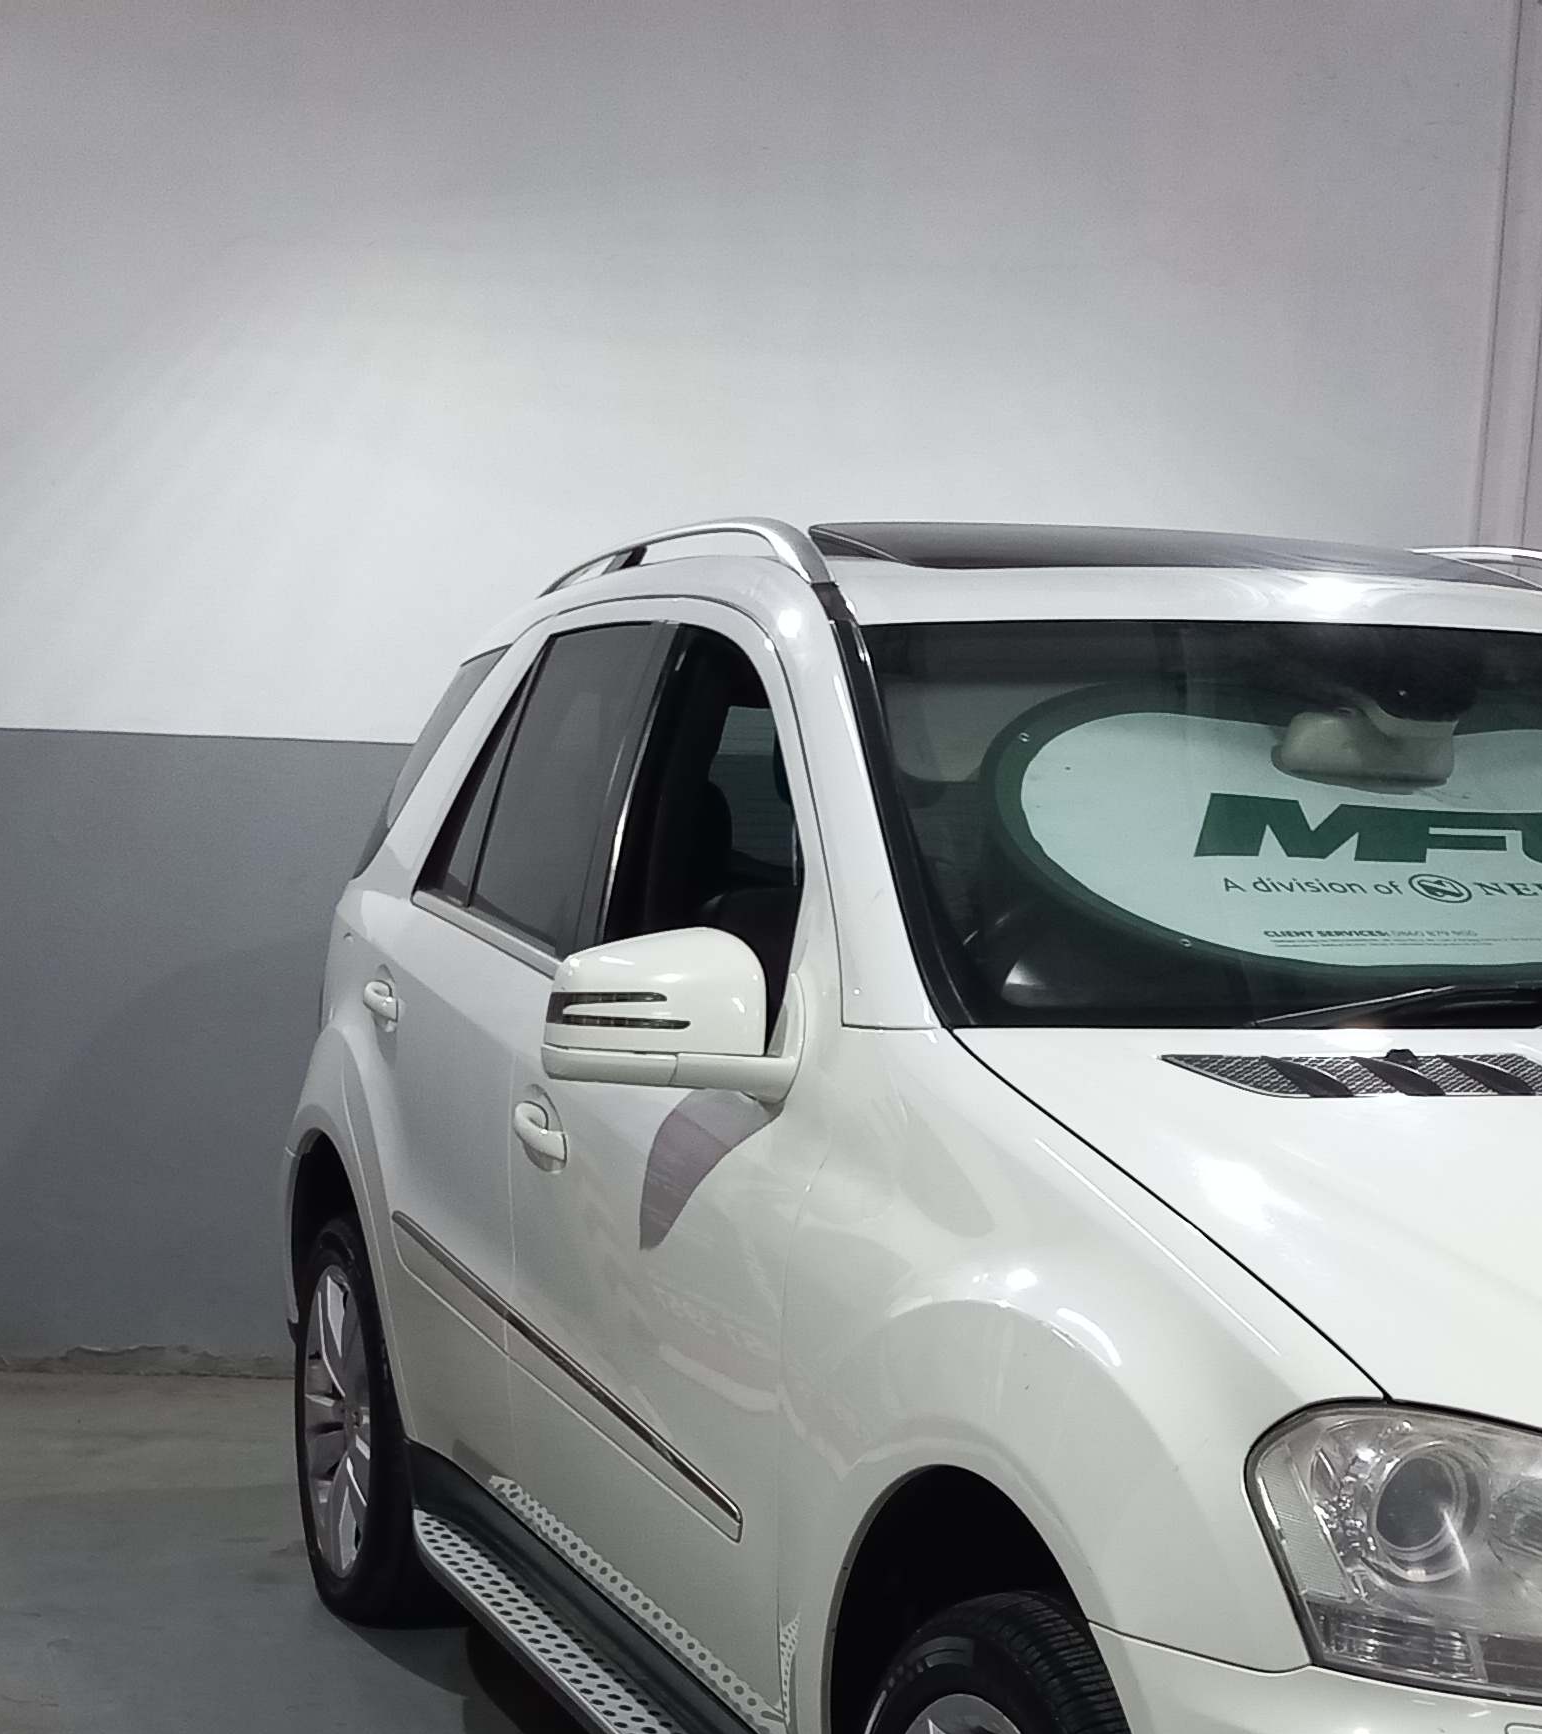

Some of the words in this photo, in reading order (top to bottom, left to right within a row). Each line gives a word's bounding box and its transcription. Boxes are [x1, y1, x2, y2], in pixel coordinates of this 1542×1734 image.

[1223, 876, 1246, 893] A
[1253, 875, 1371, 896] division
[1375, 877, 1404, 896] of
